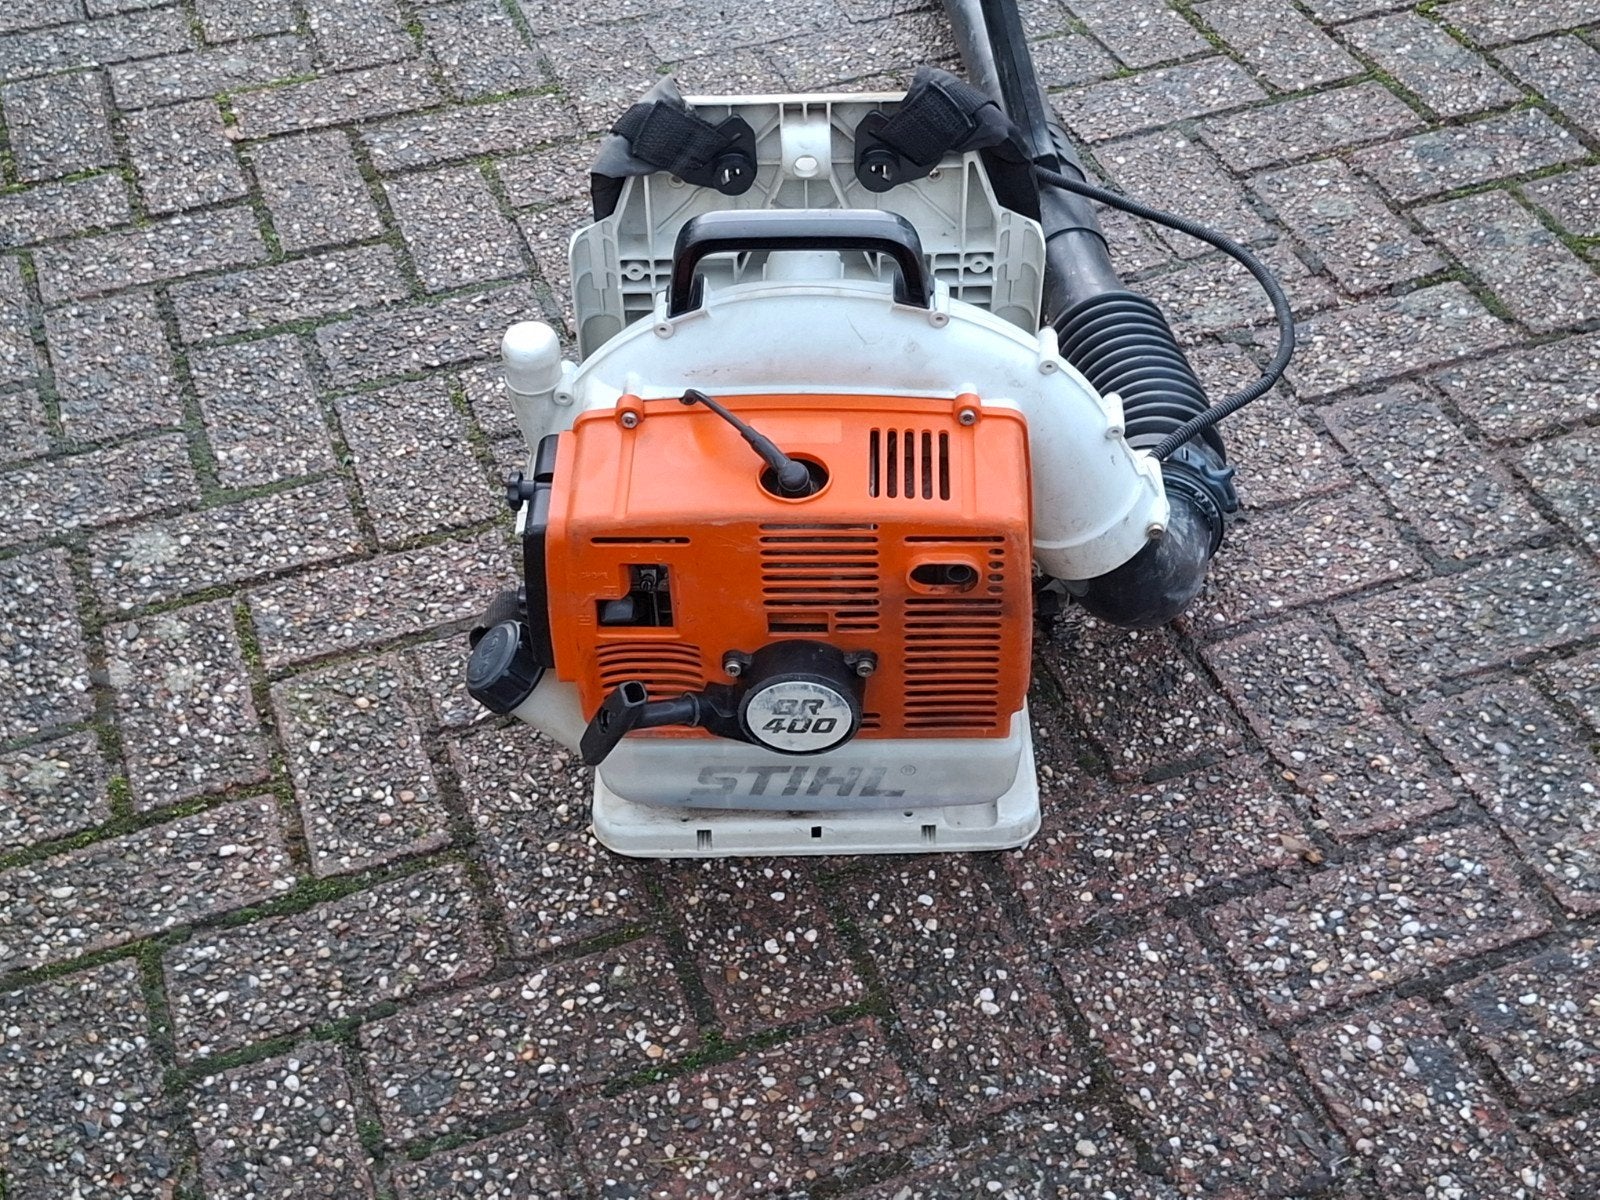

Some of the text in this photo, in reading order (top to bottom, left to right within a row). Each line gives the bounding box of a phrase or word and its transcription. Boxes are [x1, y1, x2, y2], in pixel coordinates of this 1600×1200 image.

[772, 698, 825, 715] BR
[762, 717, 837, 734] 400
[691, 765, 905, 797] STIHL
